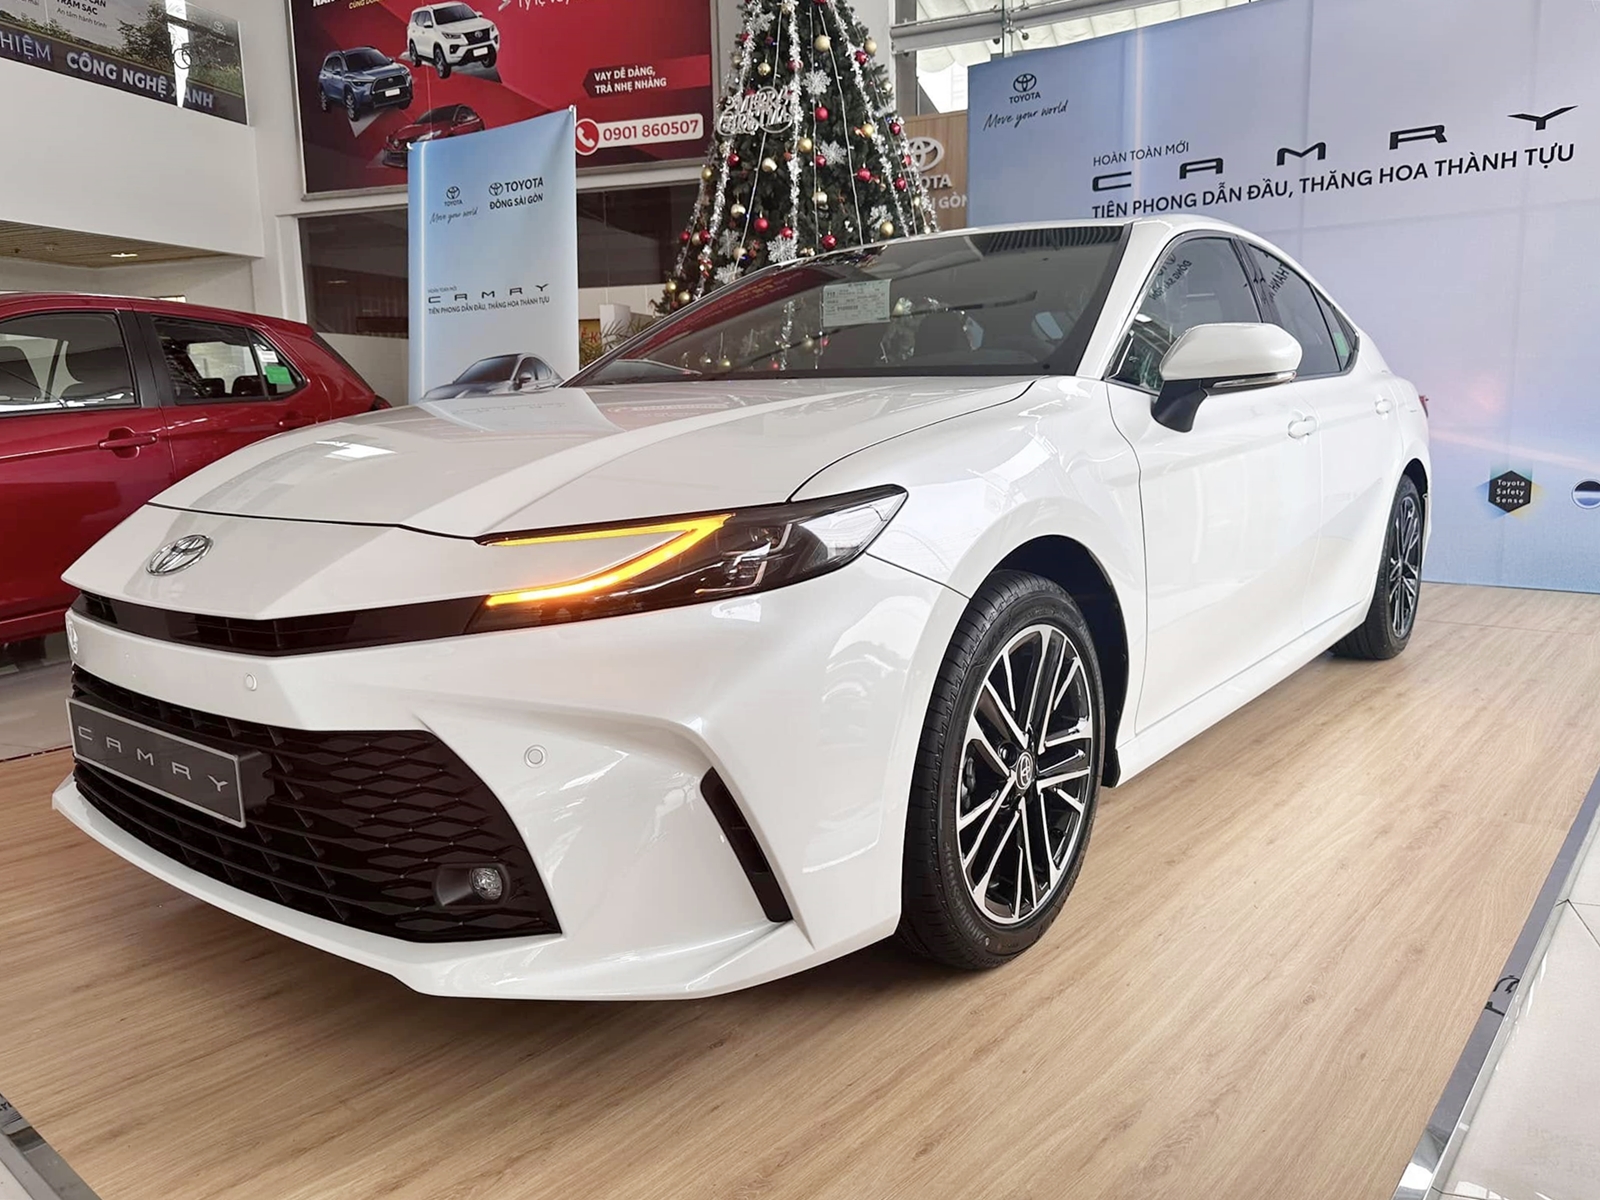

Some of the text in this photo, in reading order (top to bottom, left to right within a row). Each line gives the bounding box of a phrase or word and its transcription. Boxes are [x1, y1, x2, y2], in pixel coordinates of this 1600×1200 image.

[81, 3, 98, 15] SẠC
[66, 52, 117, 80] CÔNG
[122, 68, 168, 98] NGHỆ
[594, 71, 612, 82] VAY
[627, 65, 656, 77] DÀNG,
[595, 77, 667, 94] TRẢ NHẸ NHÀNG
[1009, 91, 1041, 104] TOYOTA
[983, 99, 1069, 131] Move your world
[603, 119, 699, 141] 0901 860507
[1093, 140, 1190, 167] HOÀN TOÀN MỚI
[505, 177, 544, 193] TOYOTA
[1092, 142, 1575, 218] TIÊN PHONG DẪN ĐẦU, THĂNG HOA THÀNH TỰU
[444, 199, 463, 207] TOYOTA
[489, 192, 544, 210] ĐÔNG SÀI GÒN
[441, 305, 461, 313] PHONG
[1496, 487, 1525, 496] Safety
[1497, 479, 1525, 488] Toyota
[1496, 496, 1524, 504] Sense
